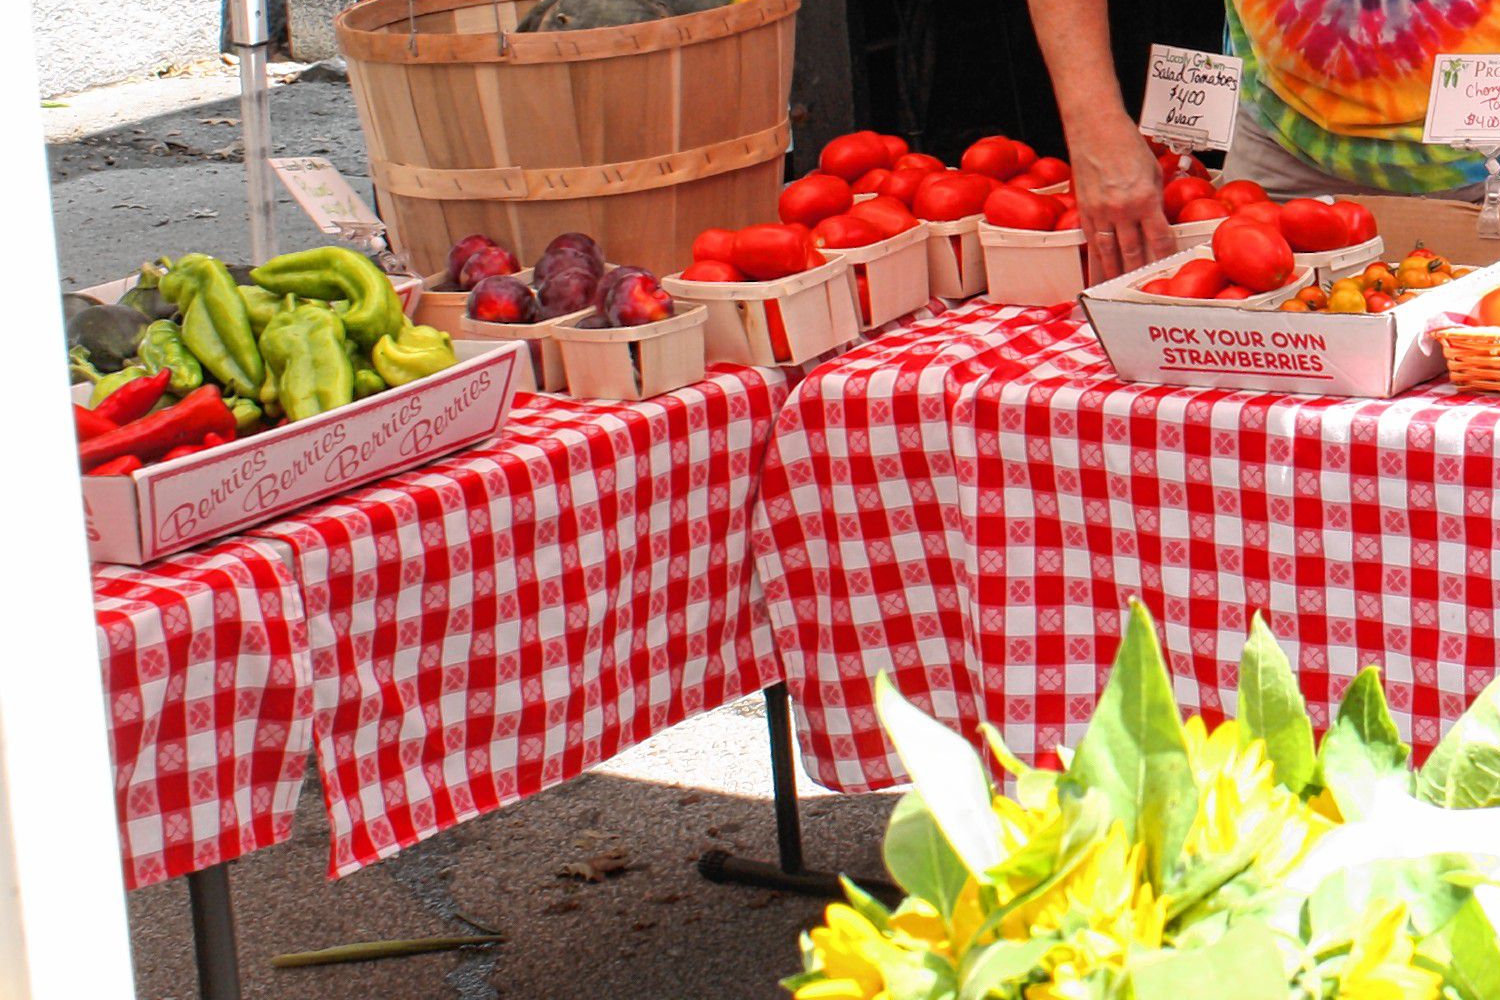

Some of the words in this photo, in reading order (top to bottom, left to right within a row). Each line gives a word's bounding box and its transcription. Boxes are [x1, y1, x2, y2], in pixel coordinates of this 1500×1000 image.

[1152, 60, 1189, 84] Salad
[1187, 67, 1238, 91] Tomatoes
[1165, 48, 1191, 65] Locally
[1148, 326, 1200, 344] PICK
[1204, 328, 1265, 347] YOUR
[1271, 331, 1327, 351] OWN
[1162, 347, 1324, 372] STRAWBERRIES
[324, 393, 423, 483] Berries
[399, 370, 492, 460] Berries
[160, 449, 269, 544] Berries
[241, 423, 348, 514] Berries
